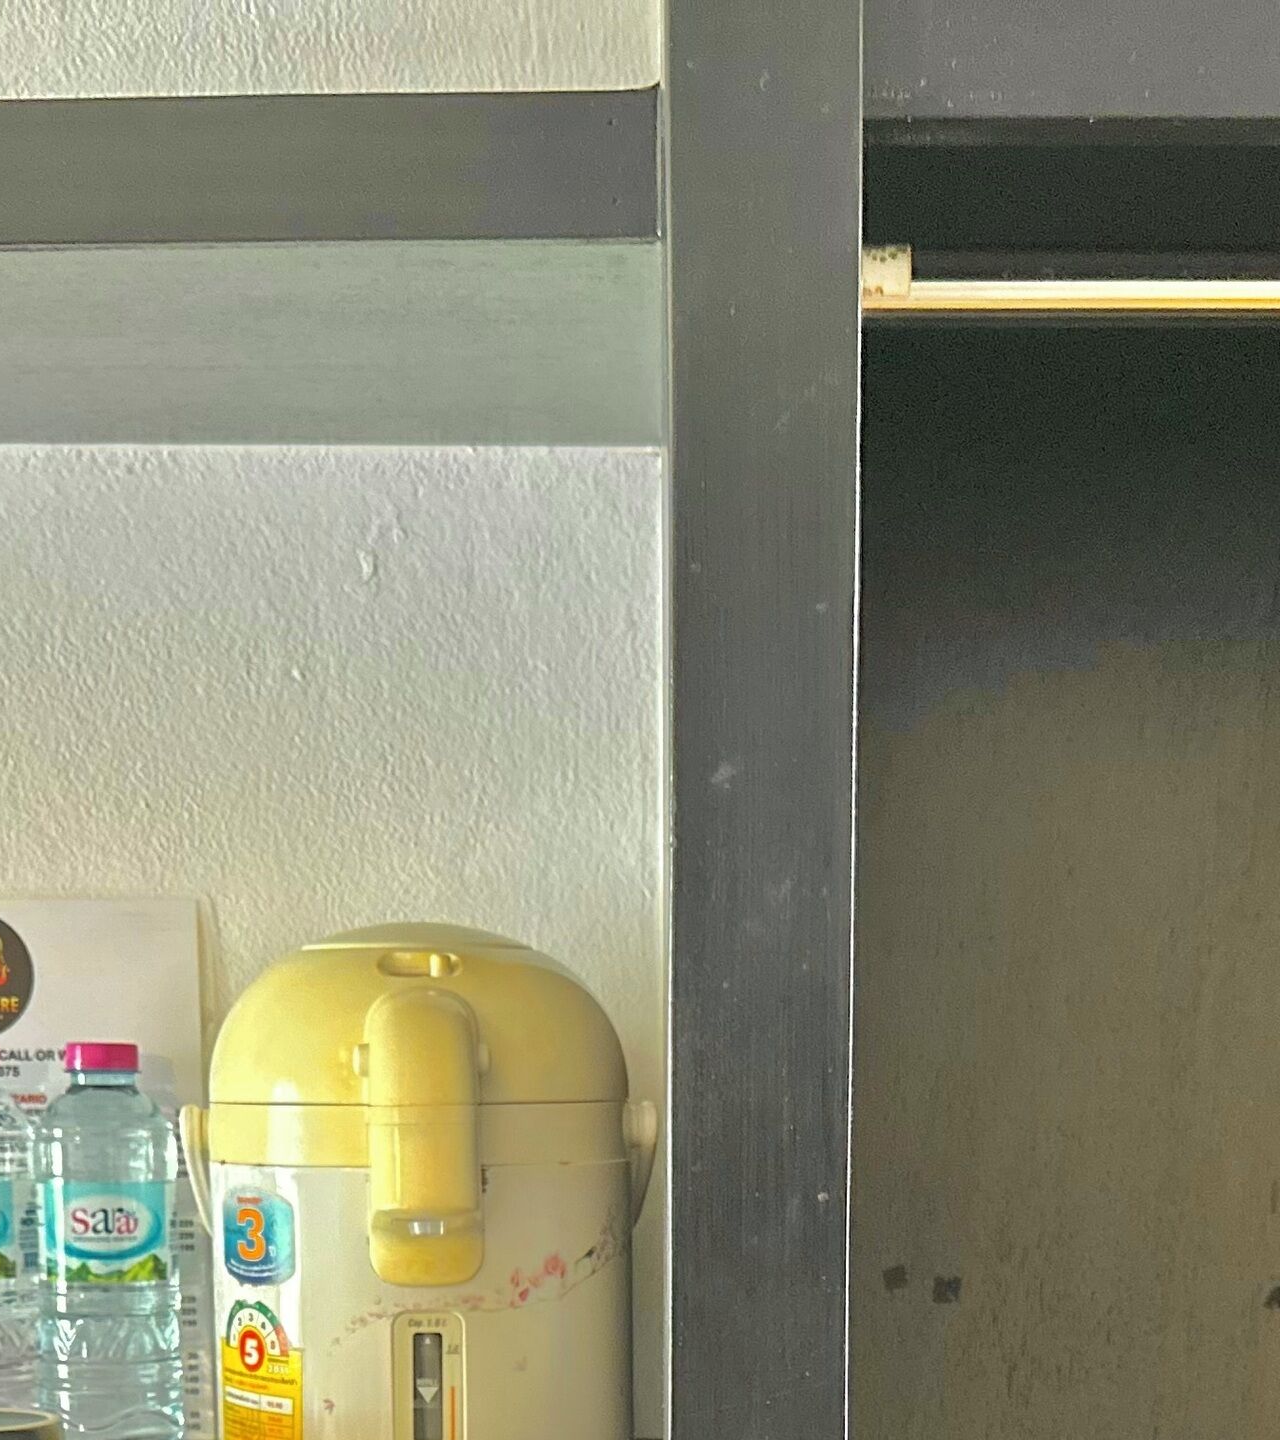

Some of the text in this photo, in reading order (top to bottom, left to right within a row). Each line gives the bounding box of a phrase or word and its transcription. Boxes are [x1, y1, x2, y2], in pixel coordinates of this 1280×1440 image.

[0, 1049, 33, 1062] CALL
[36, 1049, 56, 1062] OR
[237, 1207, 266, 1262] 3
[243, 1337, 260, 1366] 5
